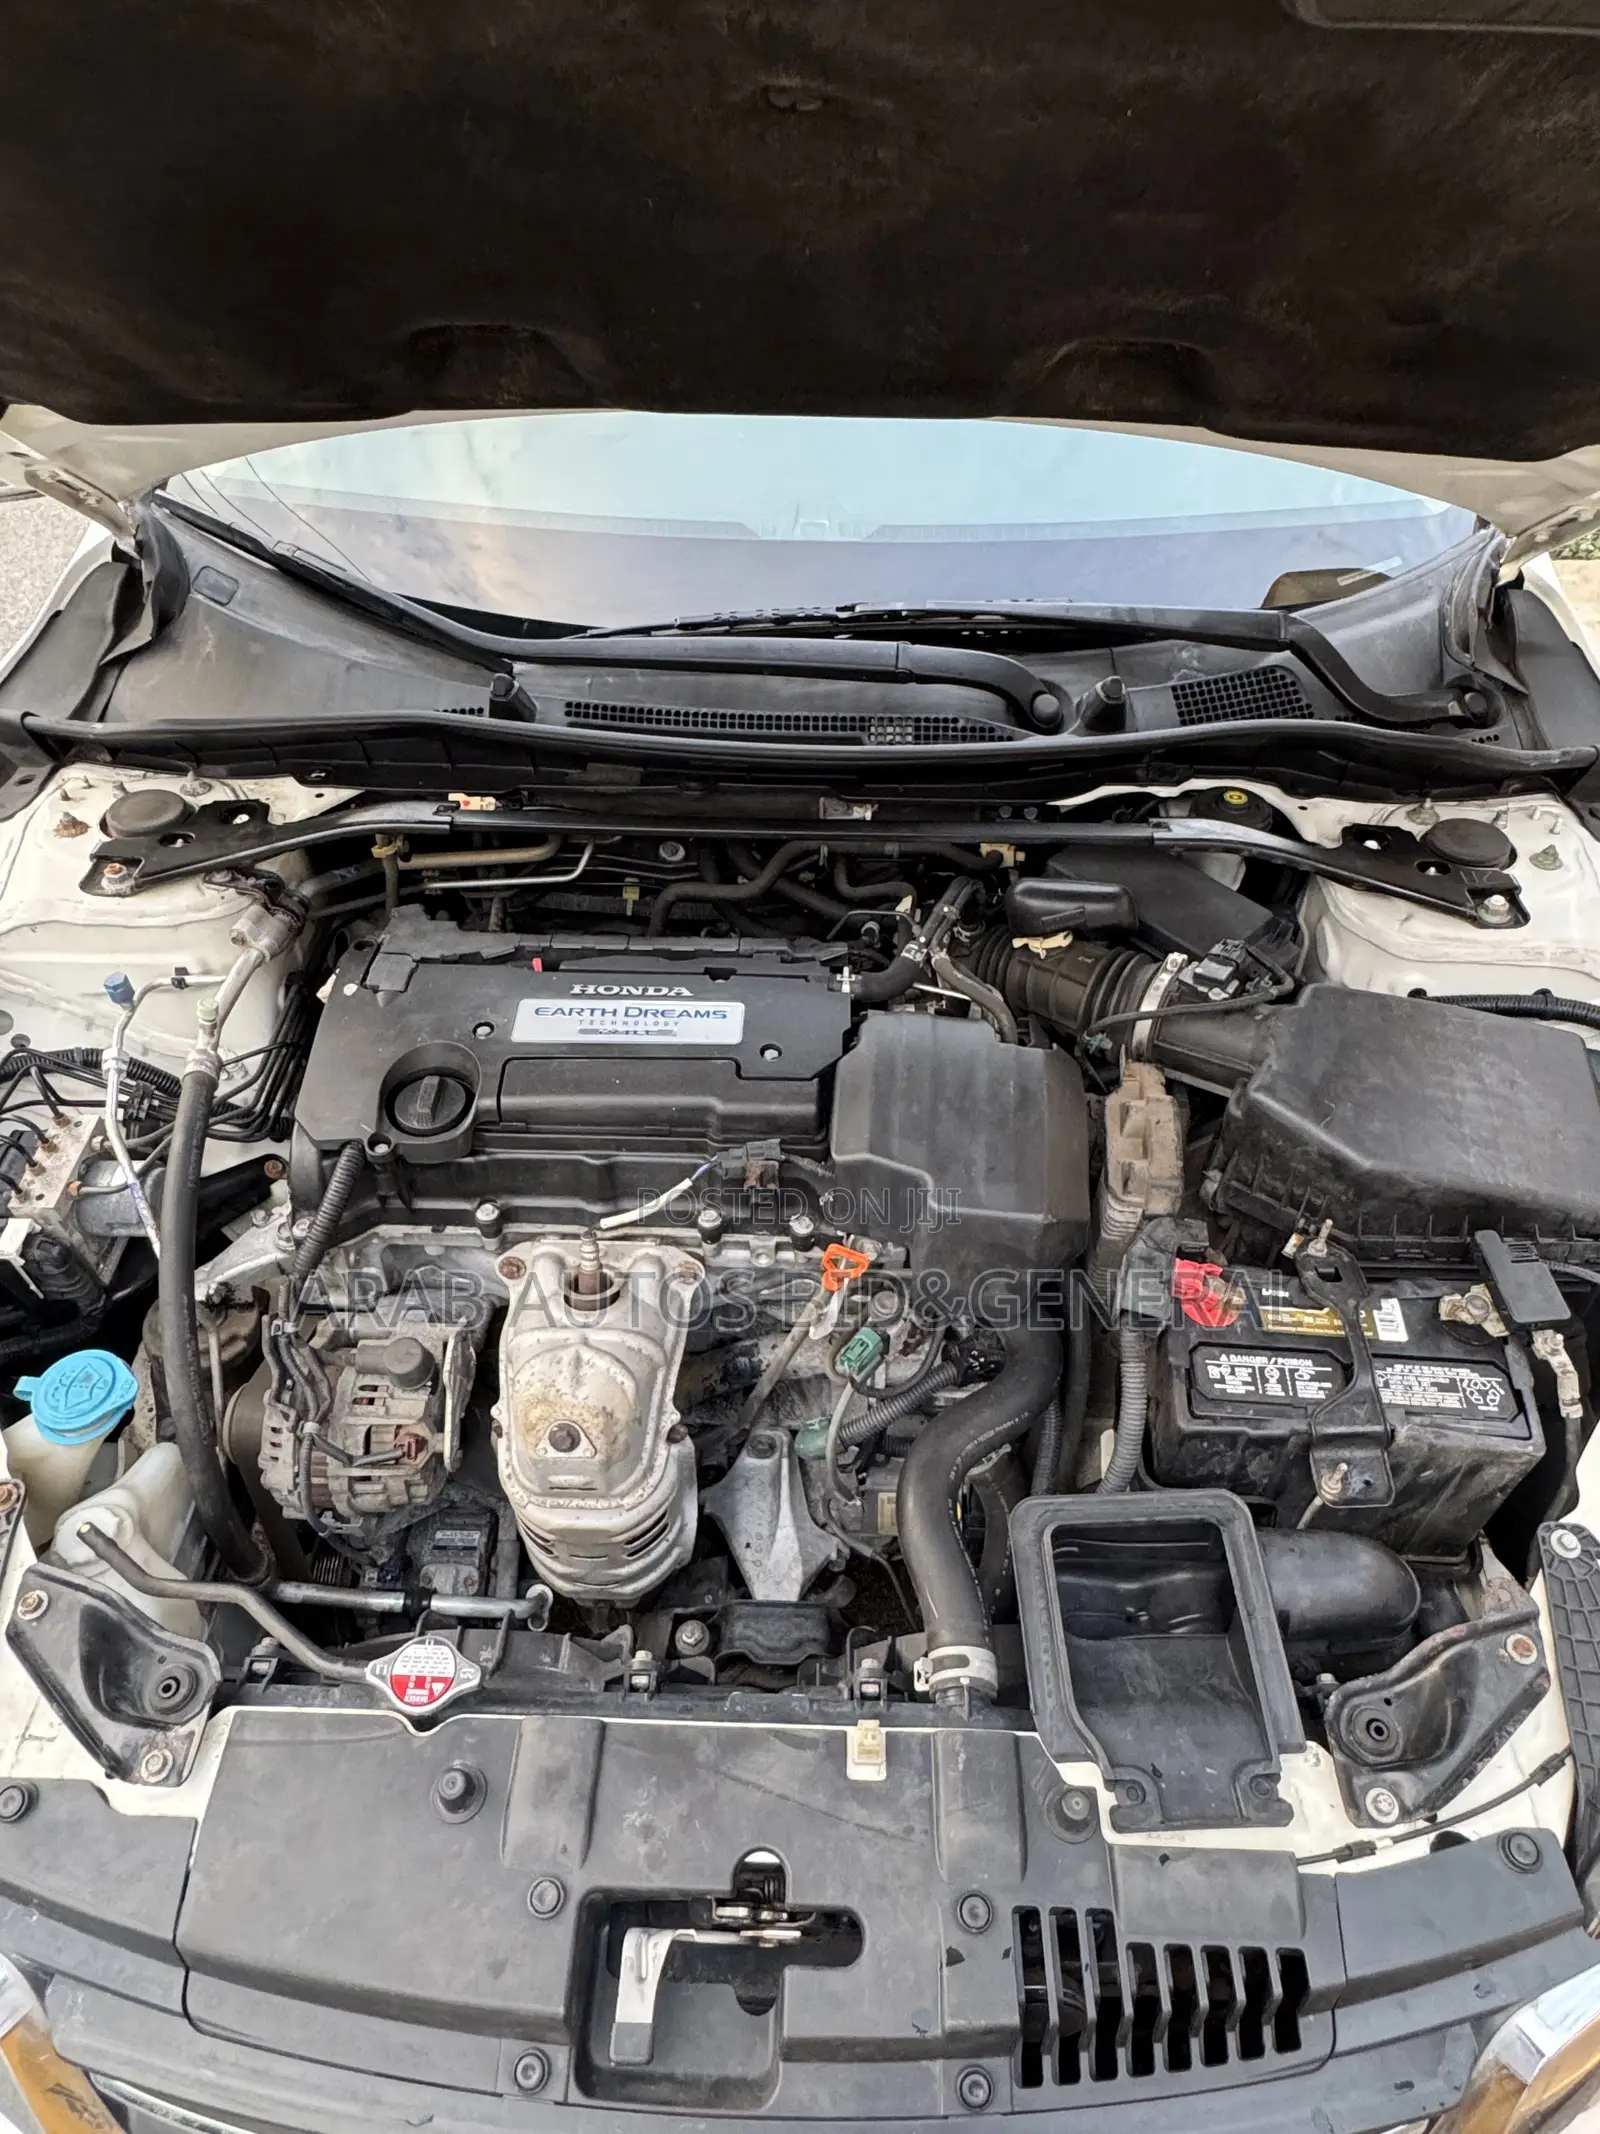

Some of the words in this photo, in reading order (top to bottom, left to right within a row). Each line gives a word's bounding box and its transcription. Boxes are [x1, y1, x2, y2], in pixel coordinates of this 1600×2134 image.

[570, 984, 694, 997] HONDA
[534, 1006, 618, 1019] EARTH
[624, 1006, 728, 1020] DREAMS
